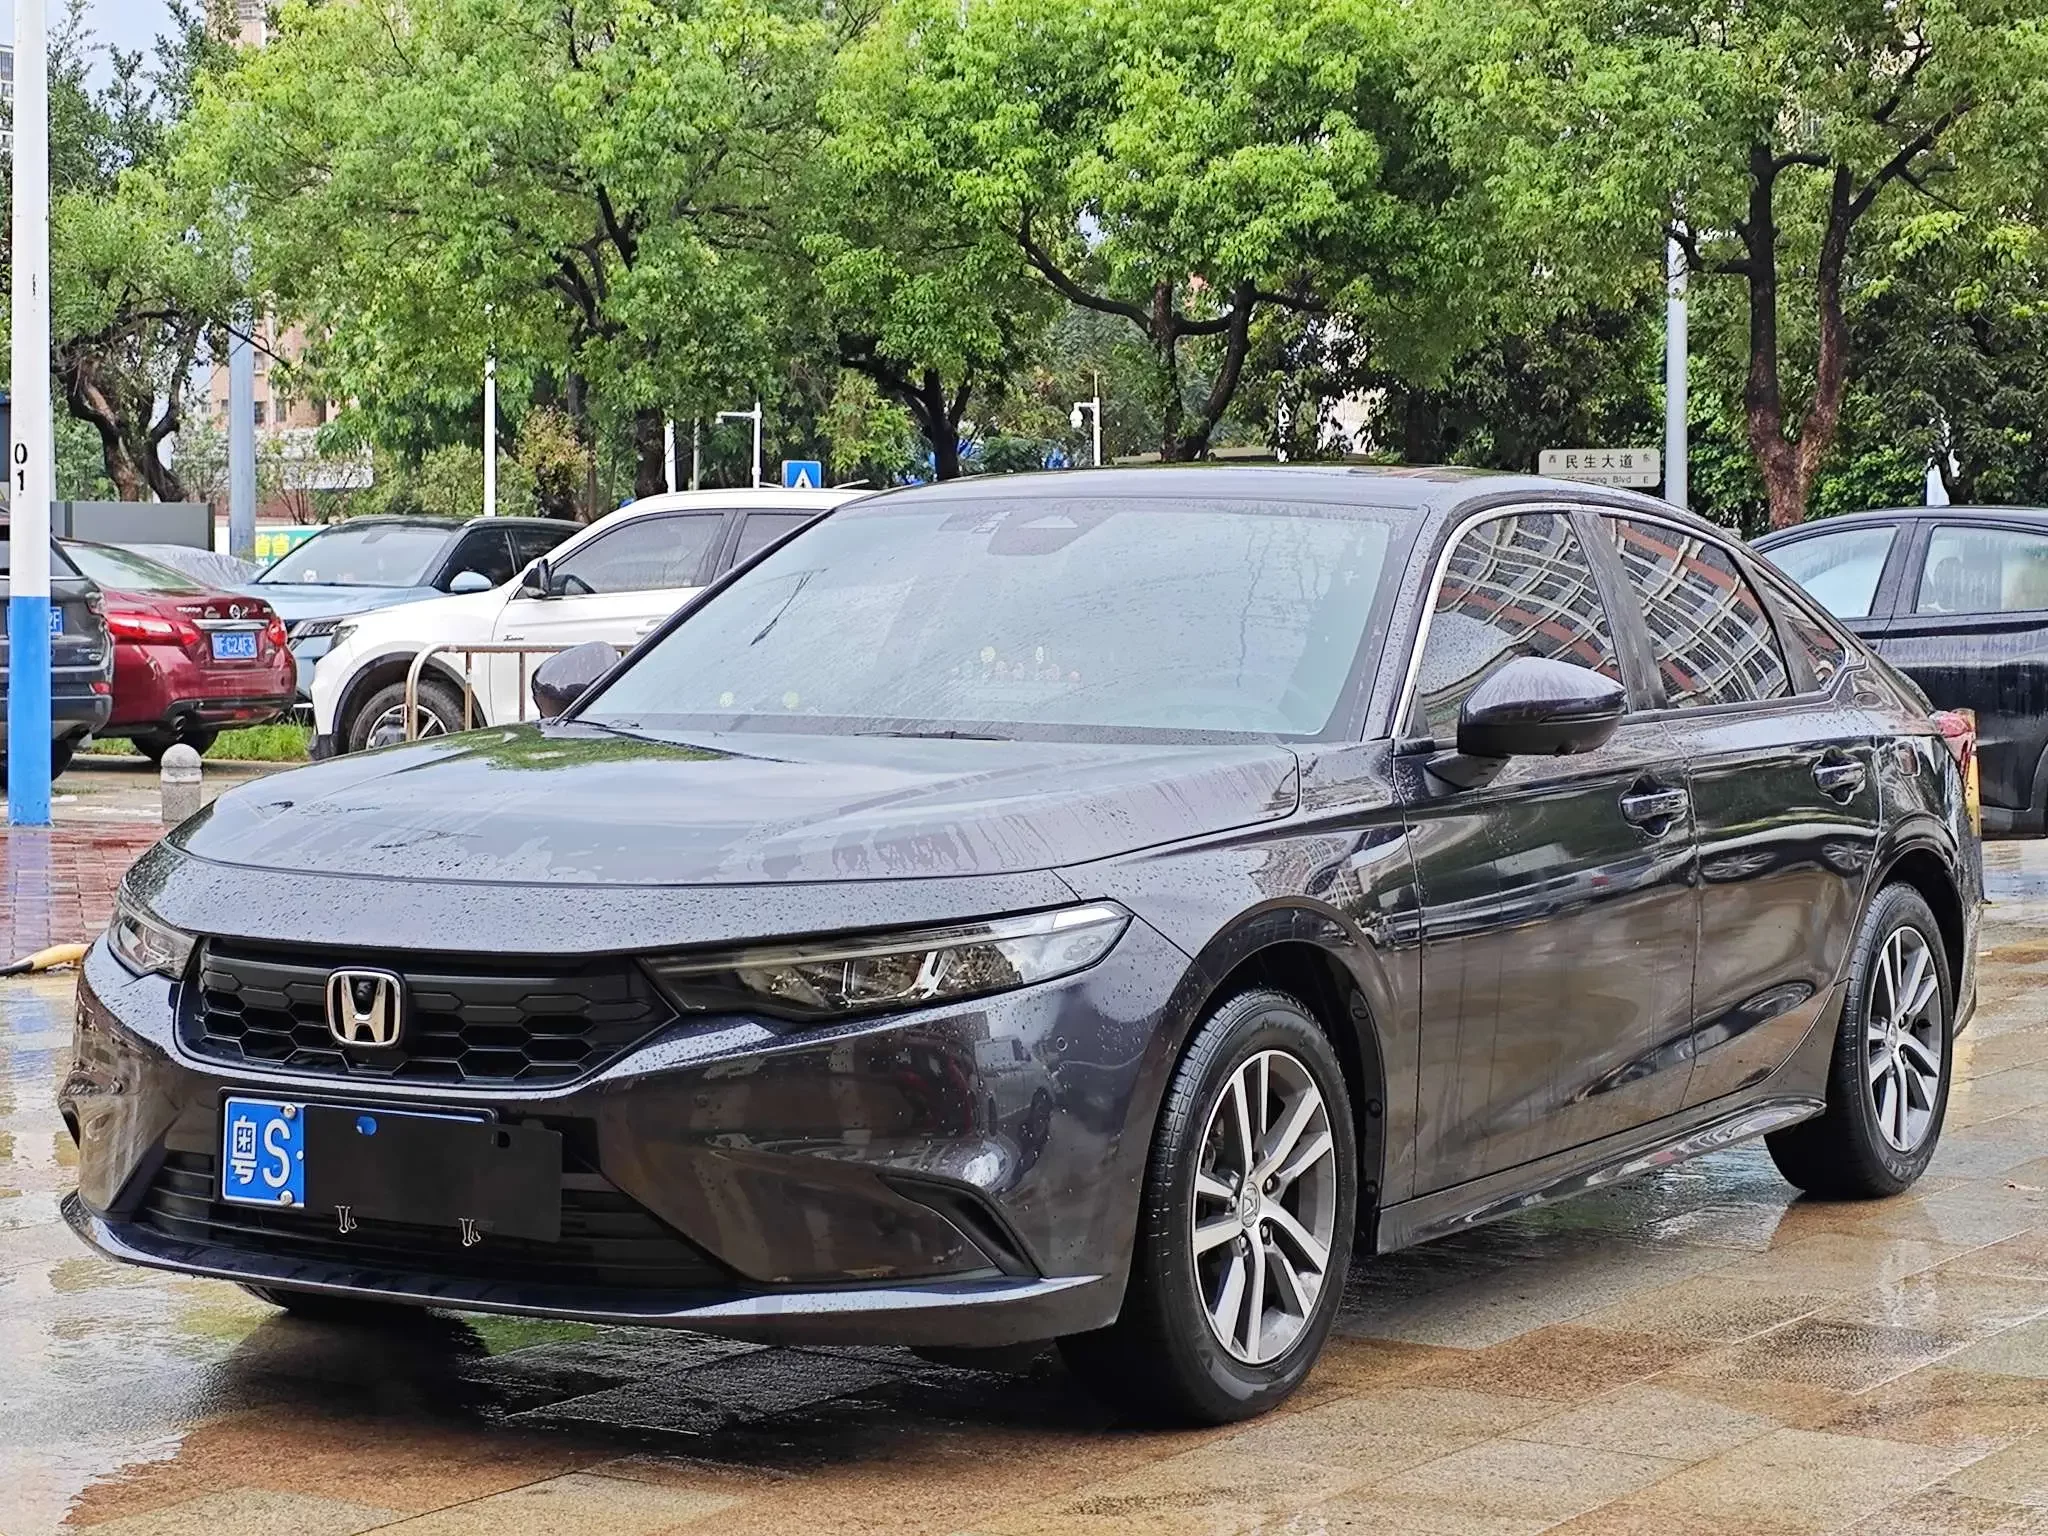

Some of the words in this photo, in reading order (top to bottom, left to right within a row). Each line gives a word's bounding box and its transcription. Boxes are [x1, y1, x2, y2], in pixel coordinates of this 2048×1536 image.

[1566, 454, 1633, 469] 民生大道
[1612, 476, 1632, 485] Blvd
[1643, 475, 1649, 484] E
